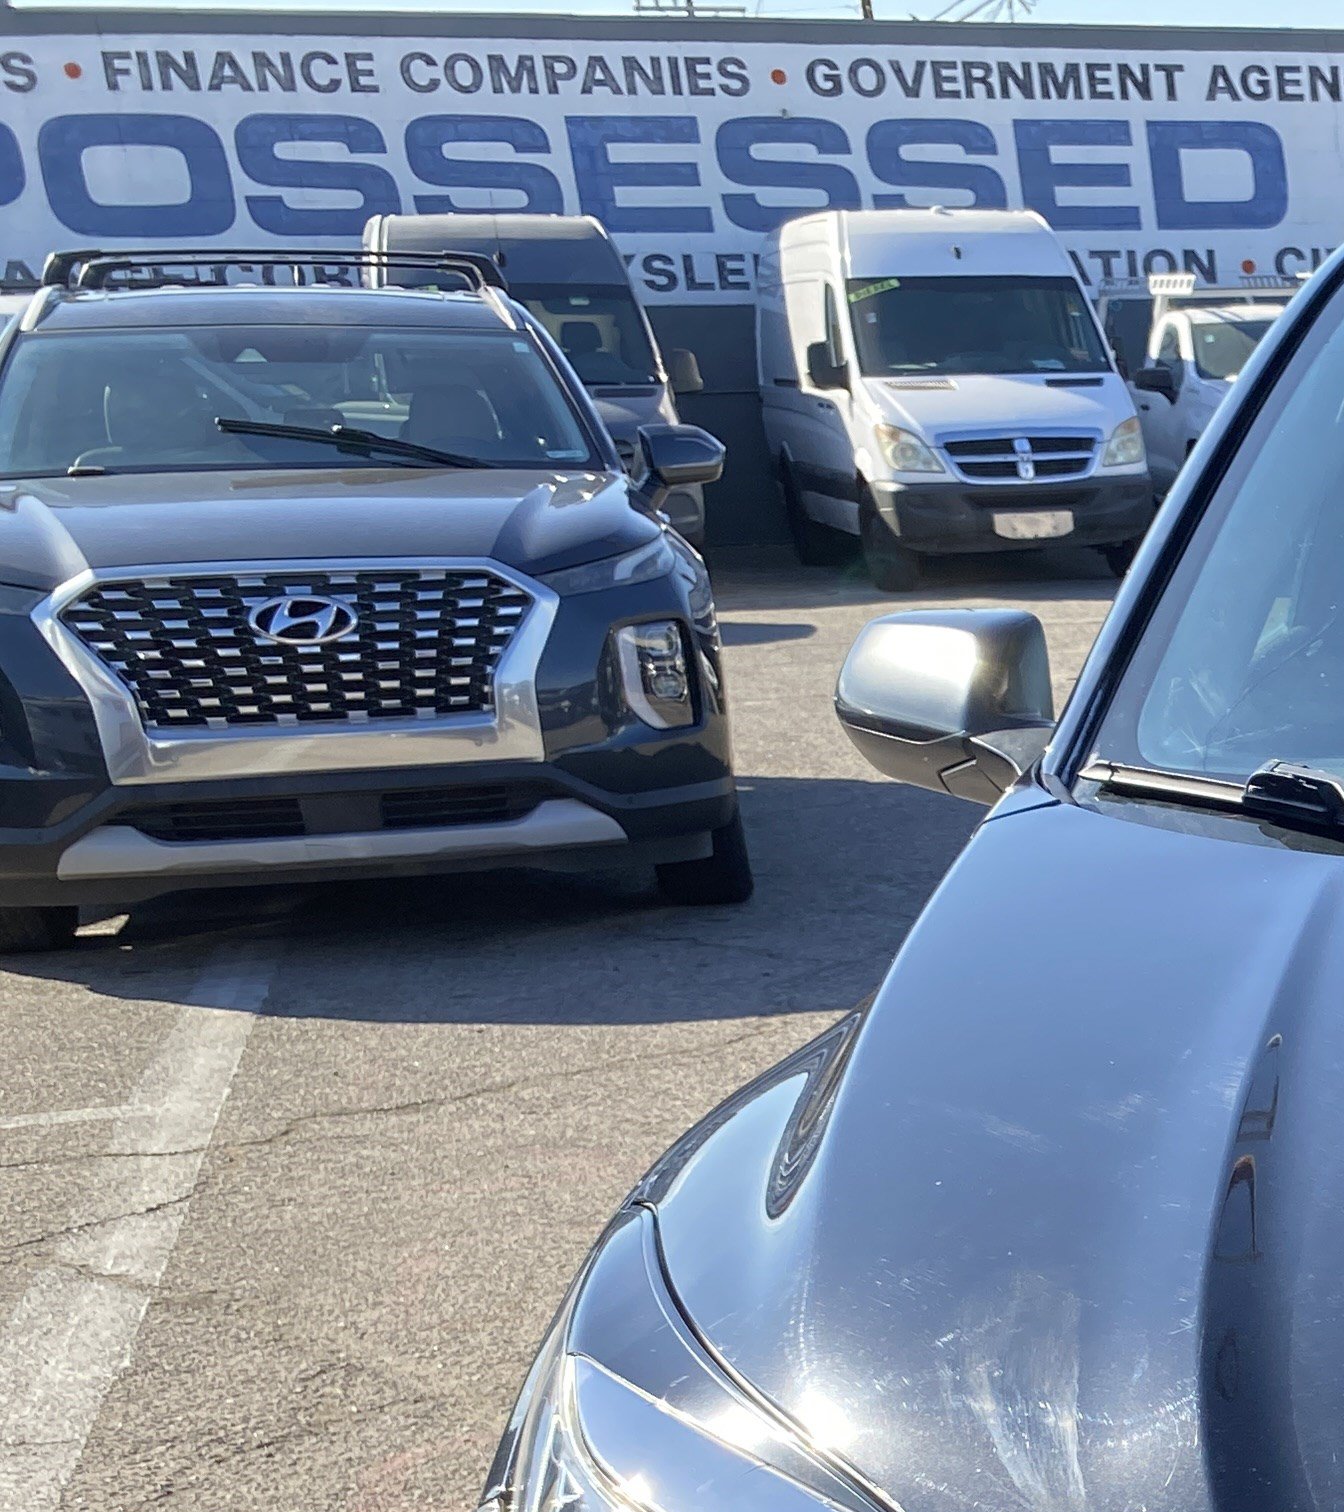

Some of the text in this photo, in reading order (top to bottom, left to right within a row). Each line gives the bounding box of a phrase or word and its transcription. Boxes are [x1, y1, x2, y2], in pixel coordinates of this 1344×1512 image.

[101, 51, 381, 95] FINANCE
[399, 52, 751, 98] COMPANIES
[805, 57, 1185, 101] GOVERNMENT
